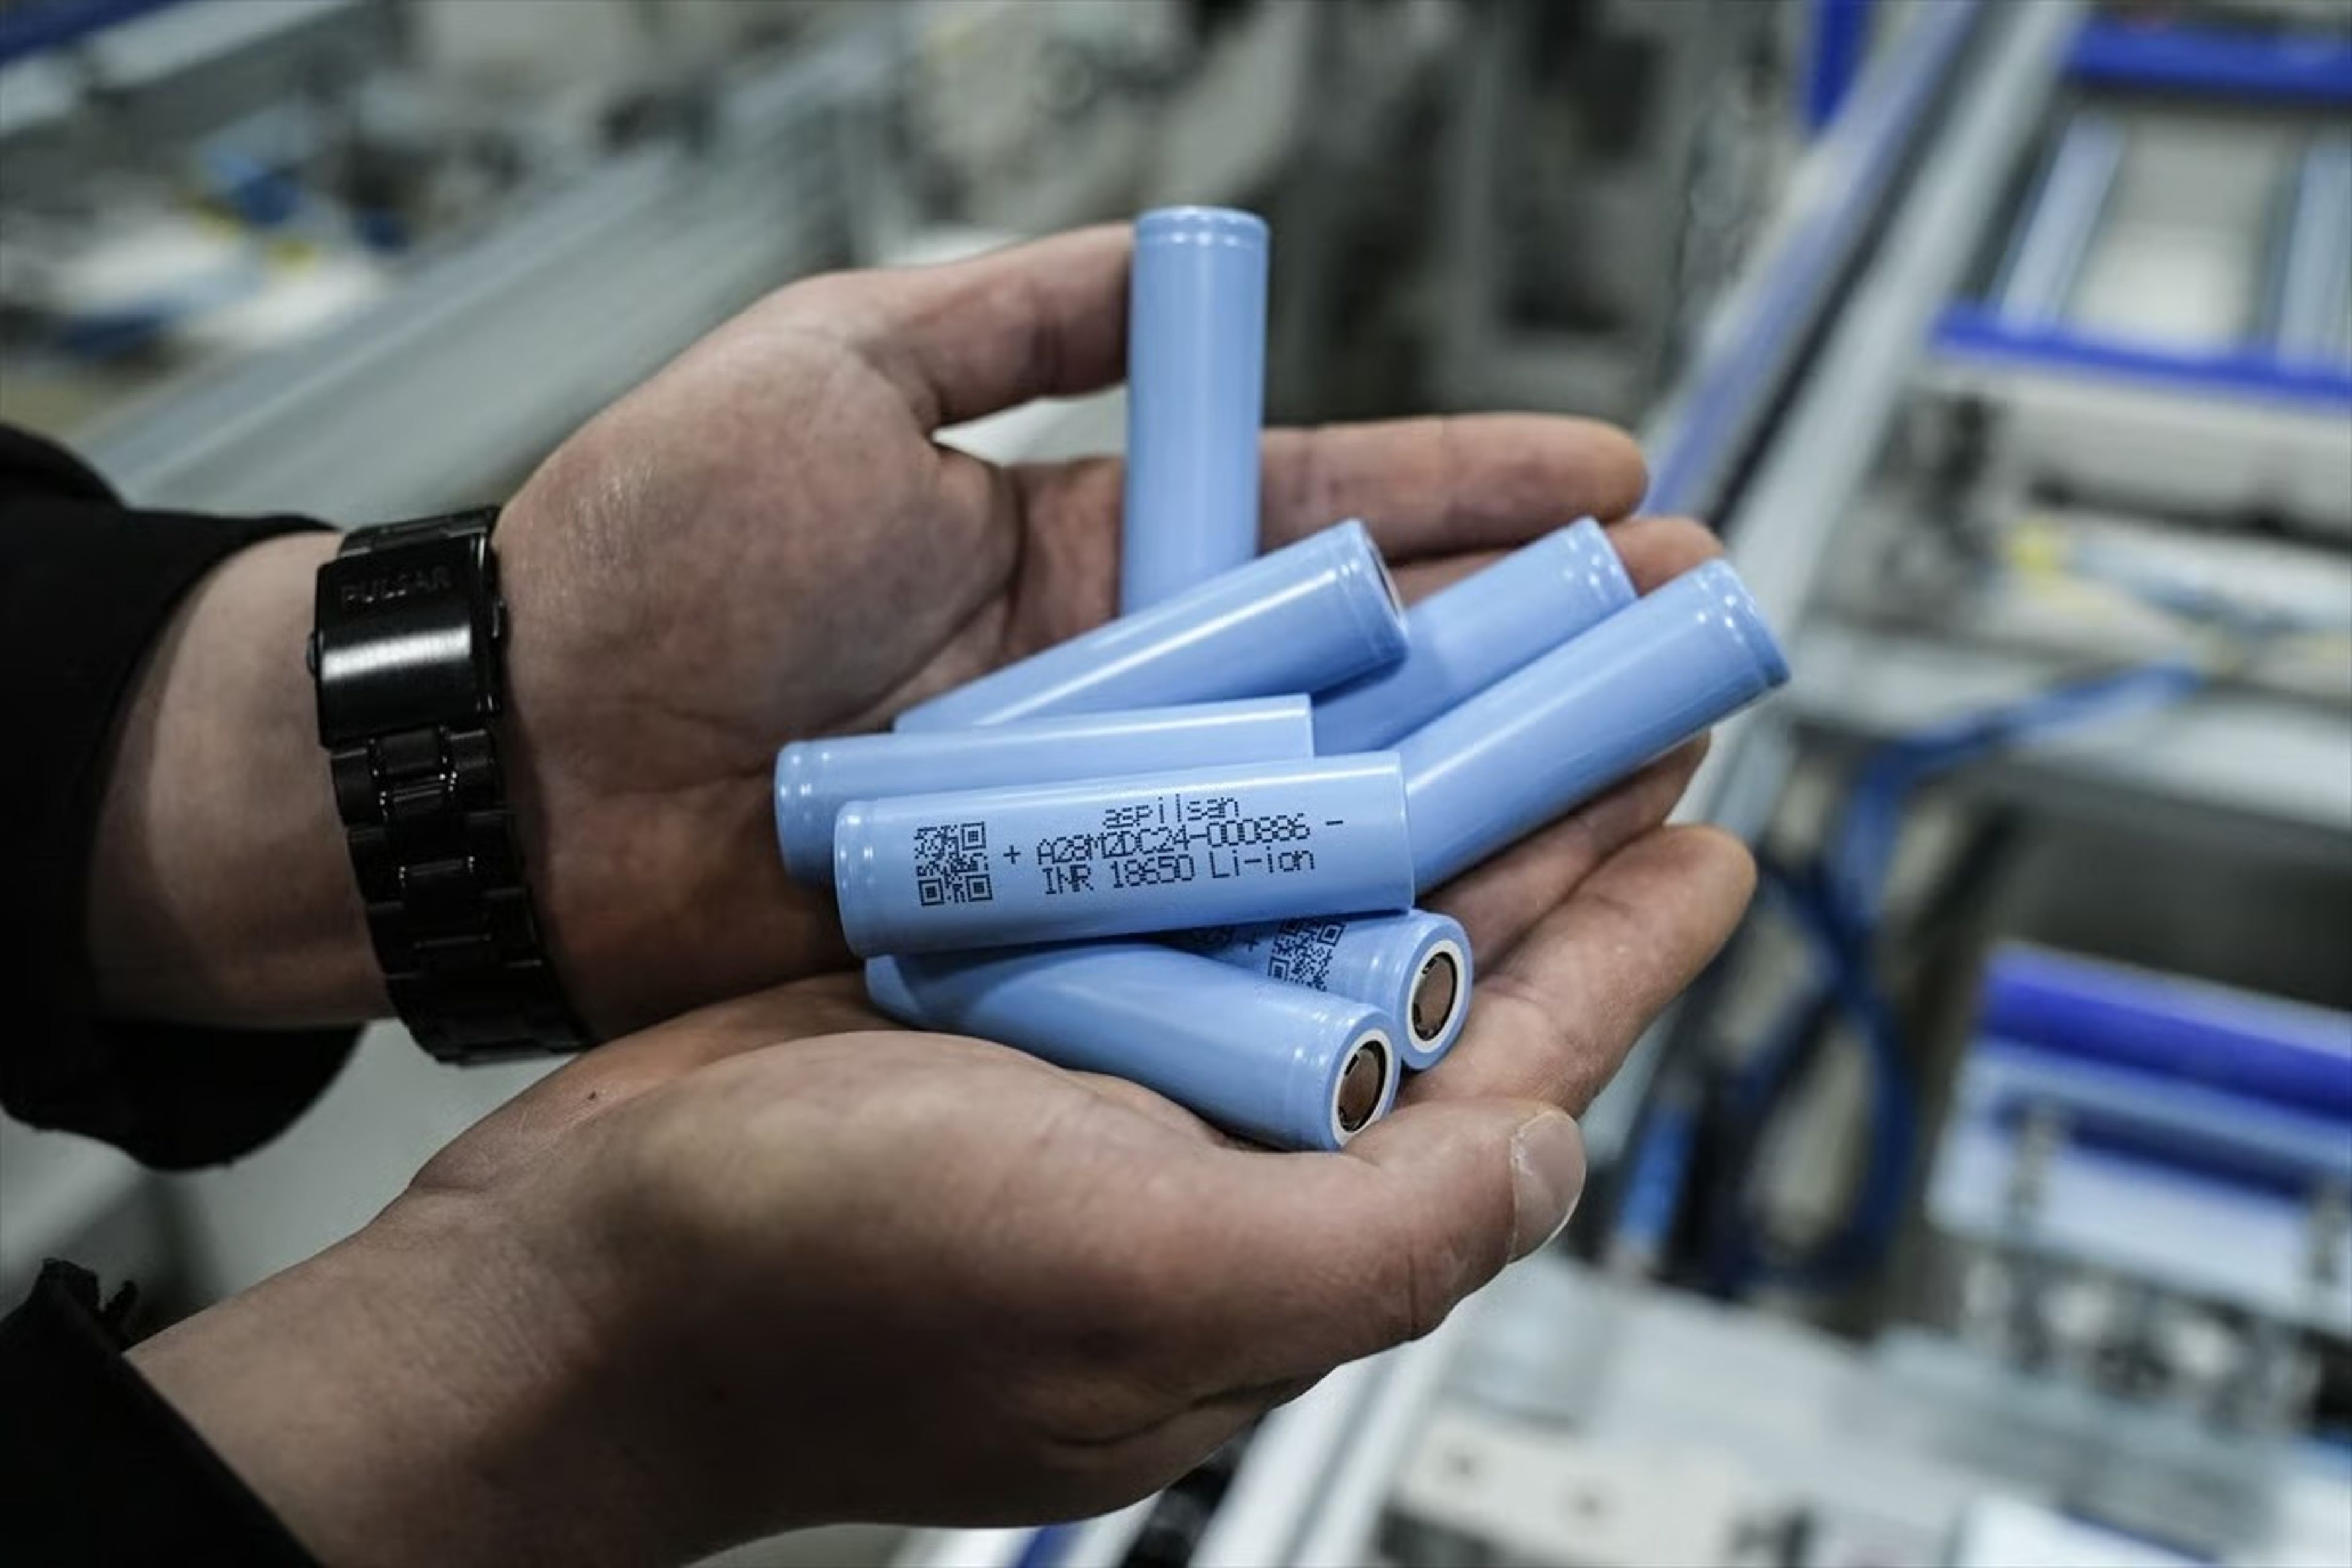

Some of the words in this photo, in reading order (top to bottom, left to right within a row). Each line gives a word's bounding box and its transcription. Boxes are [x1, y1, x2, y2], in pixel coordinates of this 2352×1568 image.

[1102, 793, 1239, 829] aspilsan
[1042, 864, 1095, 894] INR
[1110, 854, 1196, 889] 18650
[1209, 846, 1316, 879] Li-ion
